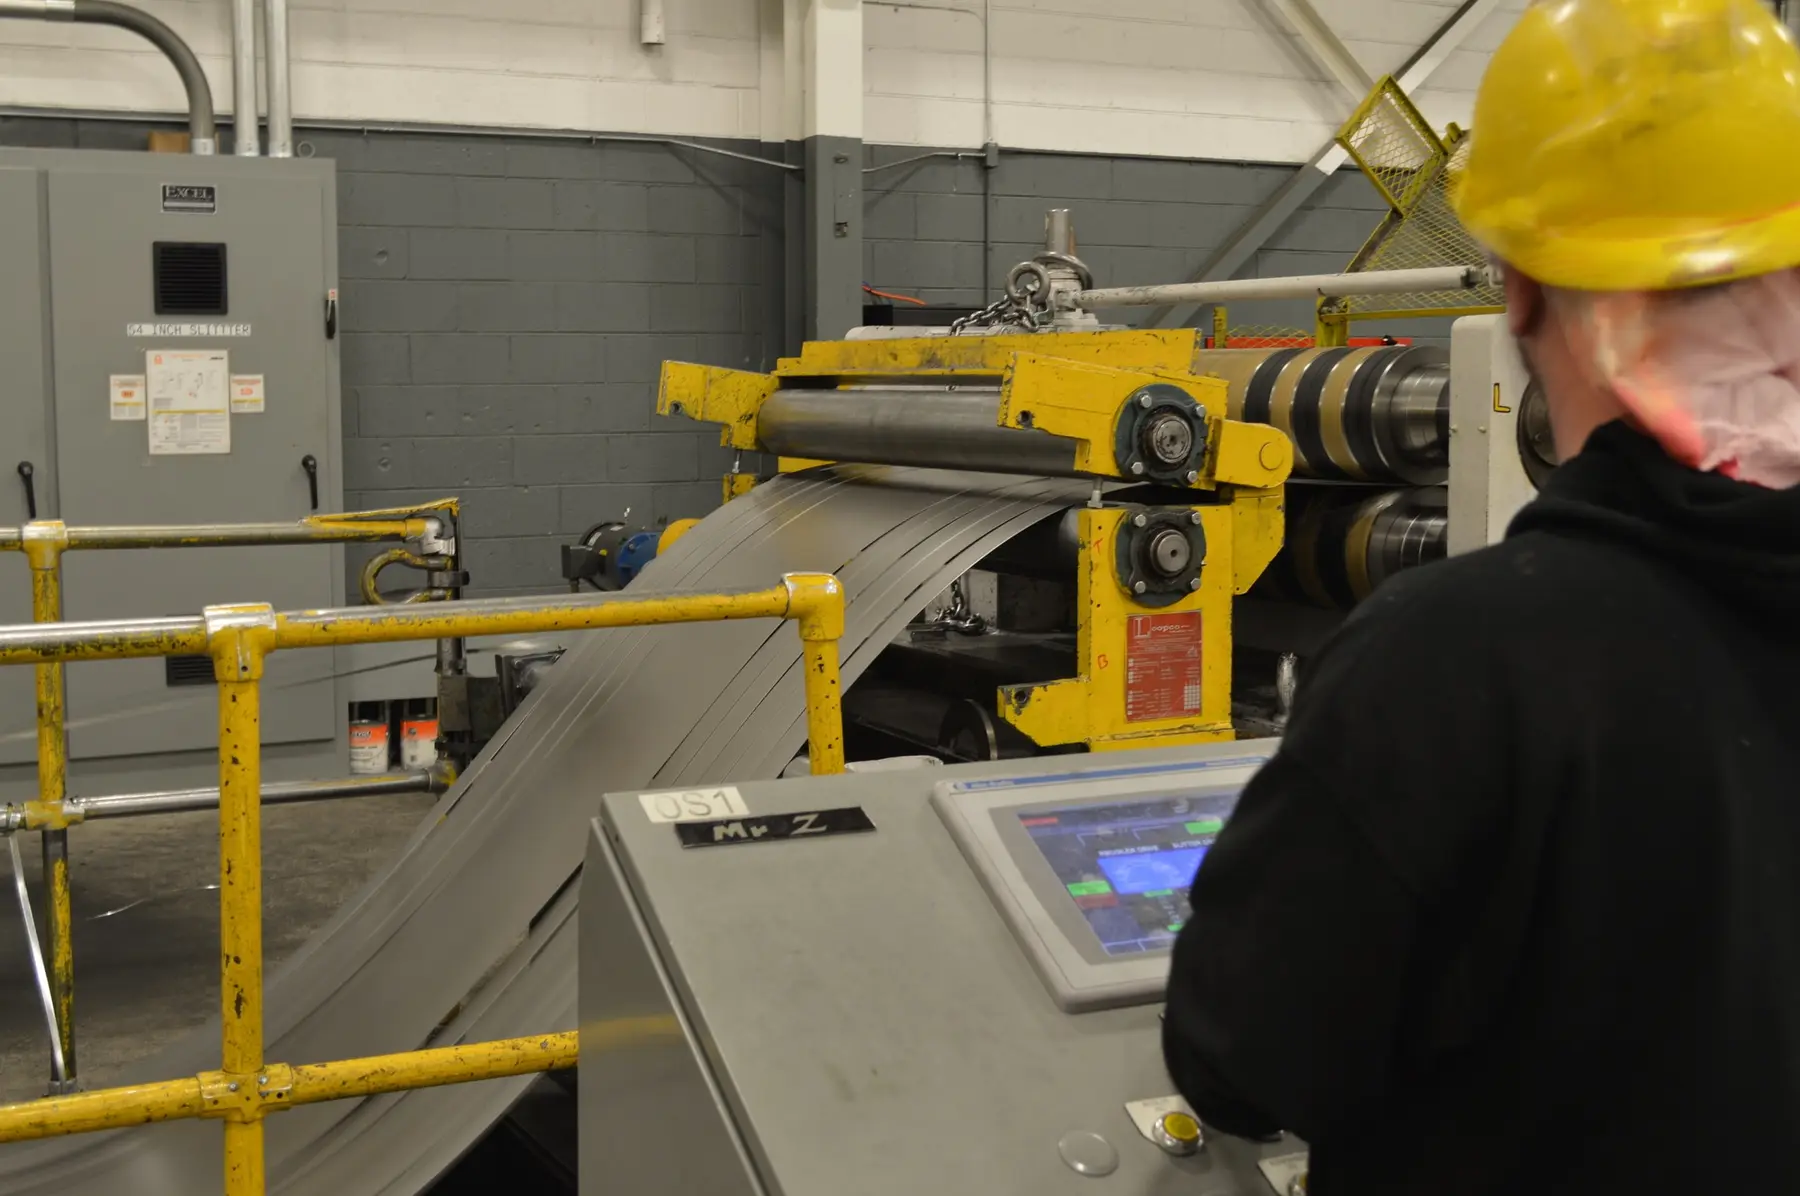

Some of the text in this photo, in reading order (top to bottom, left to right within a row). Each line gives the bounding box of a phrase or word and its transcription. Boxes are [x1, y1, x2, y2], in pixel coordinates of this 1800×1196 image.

[165, 184, 213, 199] EXCEL
[128, 323, 144, 336] 54
[152, 323, 182, 336] INCH
[1493, 382, 1511, 413] L
[1097, 654, 1109, 670] B
[713, 813, 828, 842] Mr Z
